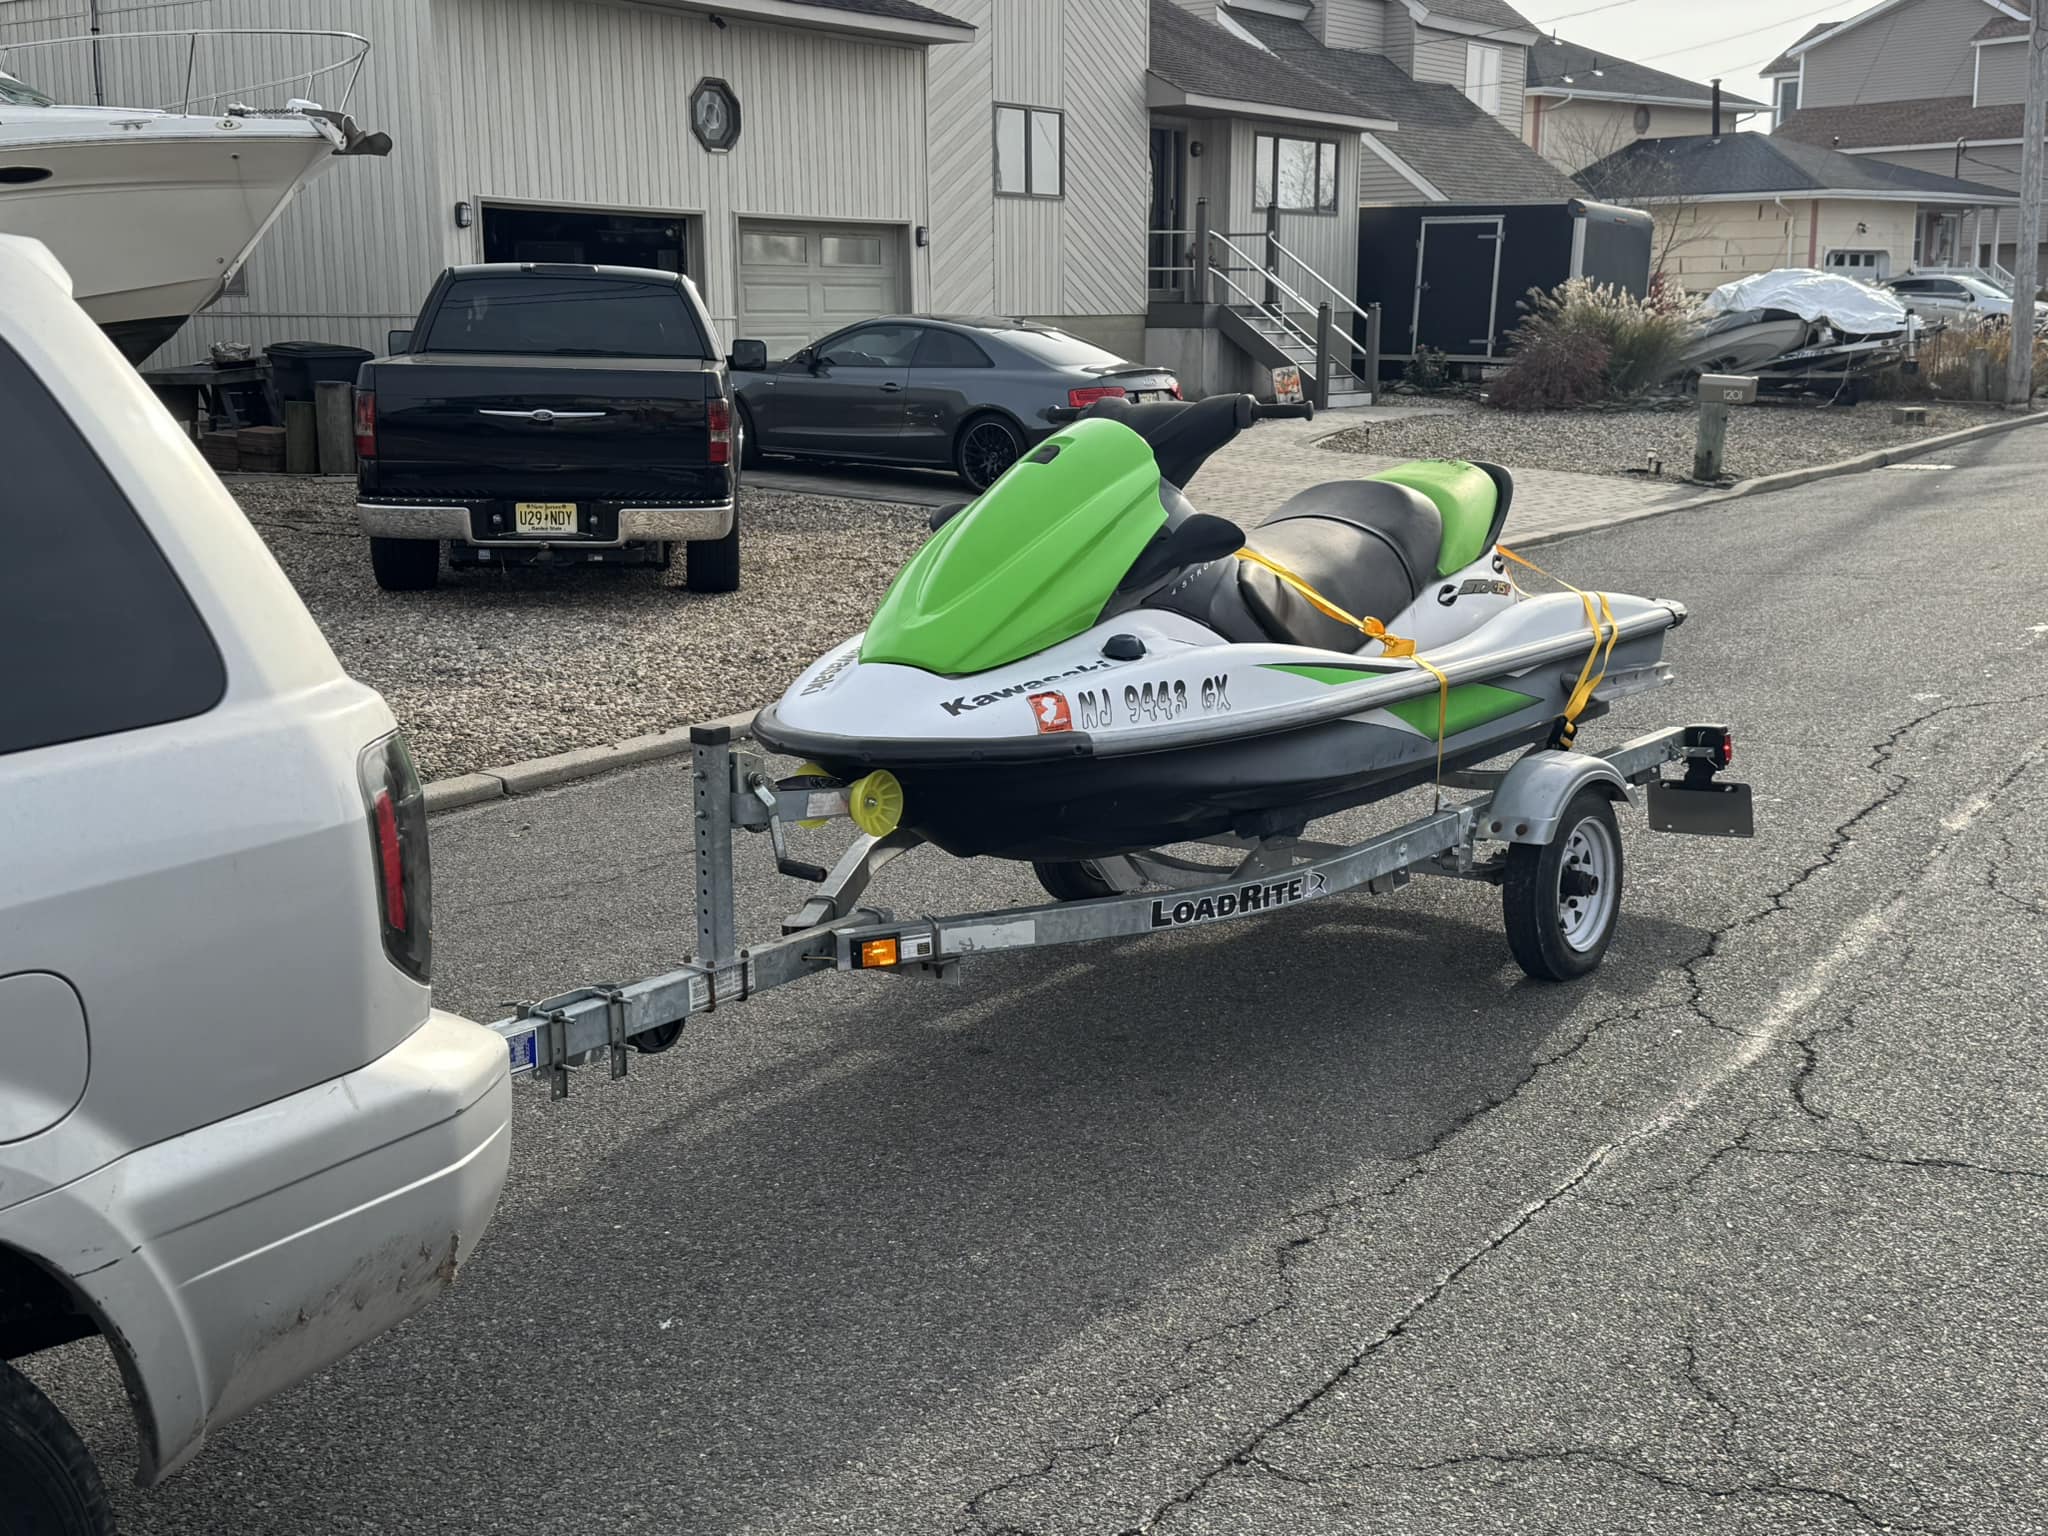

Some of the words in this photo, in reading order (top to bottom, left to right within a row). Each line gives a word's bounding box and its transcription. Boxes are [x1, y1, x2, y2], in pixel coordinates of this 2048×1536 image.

[519, 510, 542, 526] U29
[550, 510, 572, 526] NDY
[1078, 688, 1113, 730] NJ
[1201, 673, 1232, 712] GX
